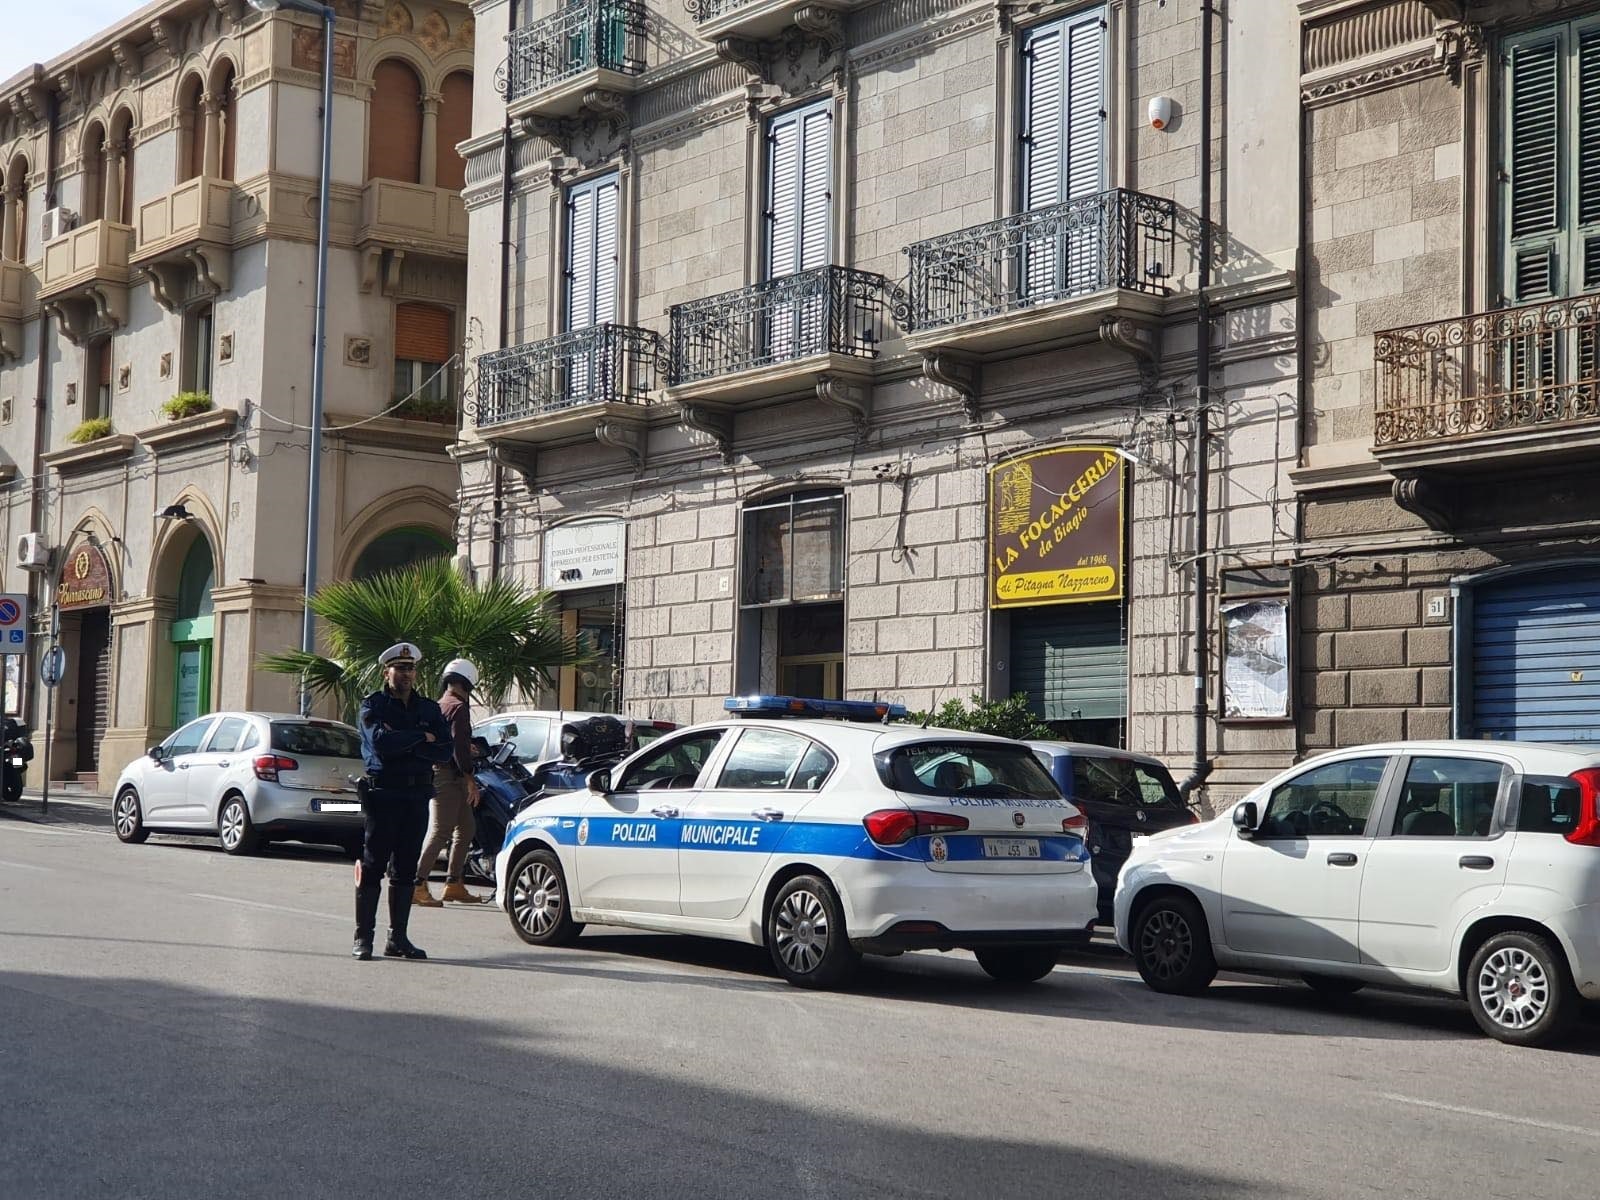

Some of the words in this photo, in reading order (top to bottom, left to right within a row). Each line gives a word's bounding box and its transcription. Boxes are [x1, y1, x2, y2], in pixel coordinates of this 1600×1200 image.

[996, 546, 1019, 573] LA
[1018, 451, 1118, 550] FOCACCERIA
[1039, 540, 1053, 558] da
[1054, 506, 1088, 543] Biagio
[574, 541, 617, 555] PROFESSIONALE
[593, 552, 619, 563] ESTETICA
[1000, 580, 1011, 593] di
[1014, 578, 1055, 595] Pitagna
[1057, 573, 1110, 592] Nazzareno
[1430, 600, 1441, 613] 51
[949, 796, 998, 807] POLIZIA
[1001, 798, 1068, 809] MUNICIPALE
[611, 823, 657, 842] POLIZIA
[681, 824, 761, 846] MUNICIPALE
